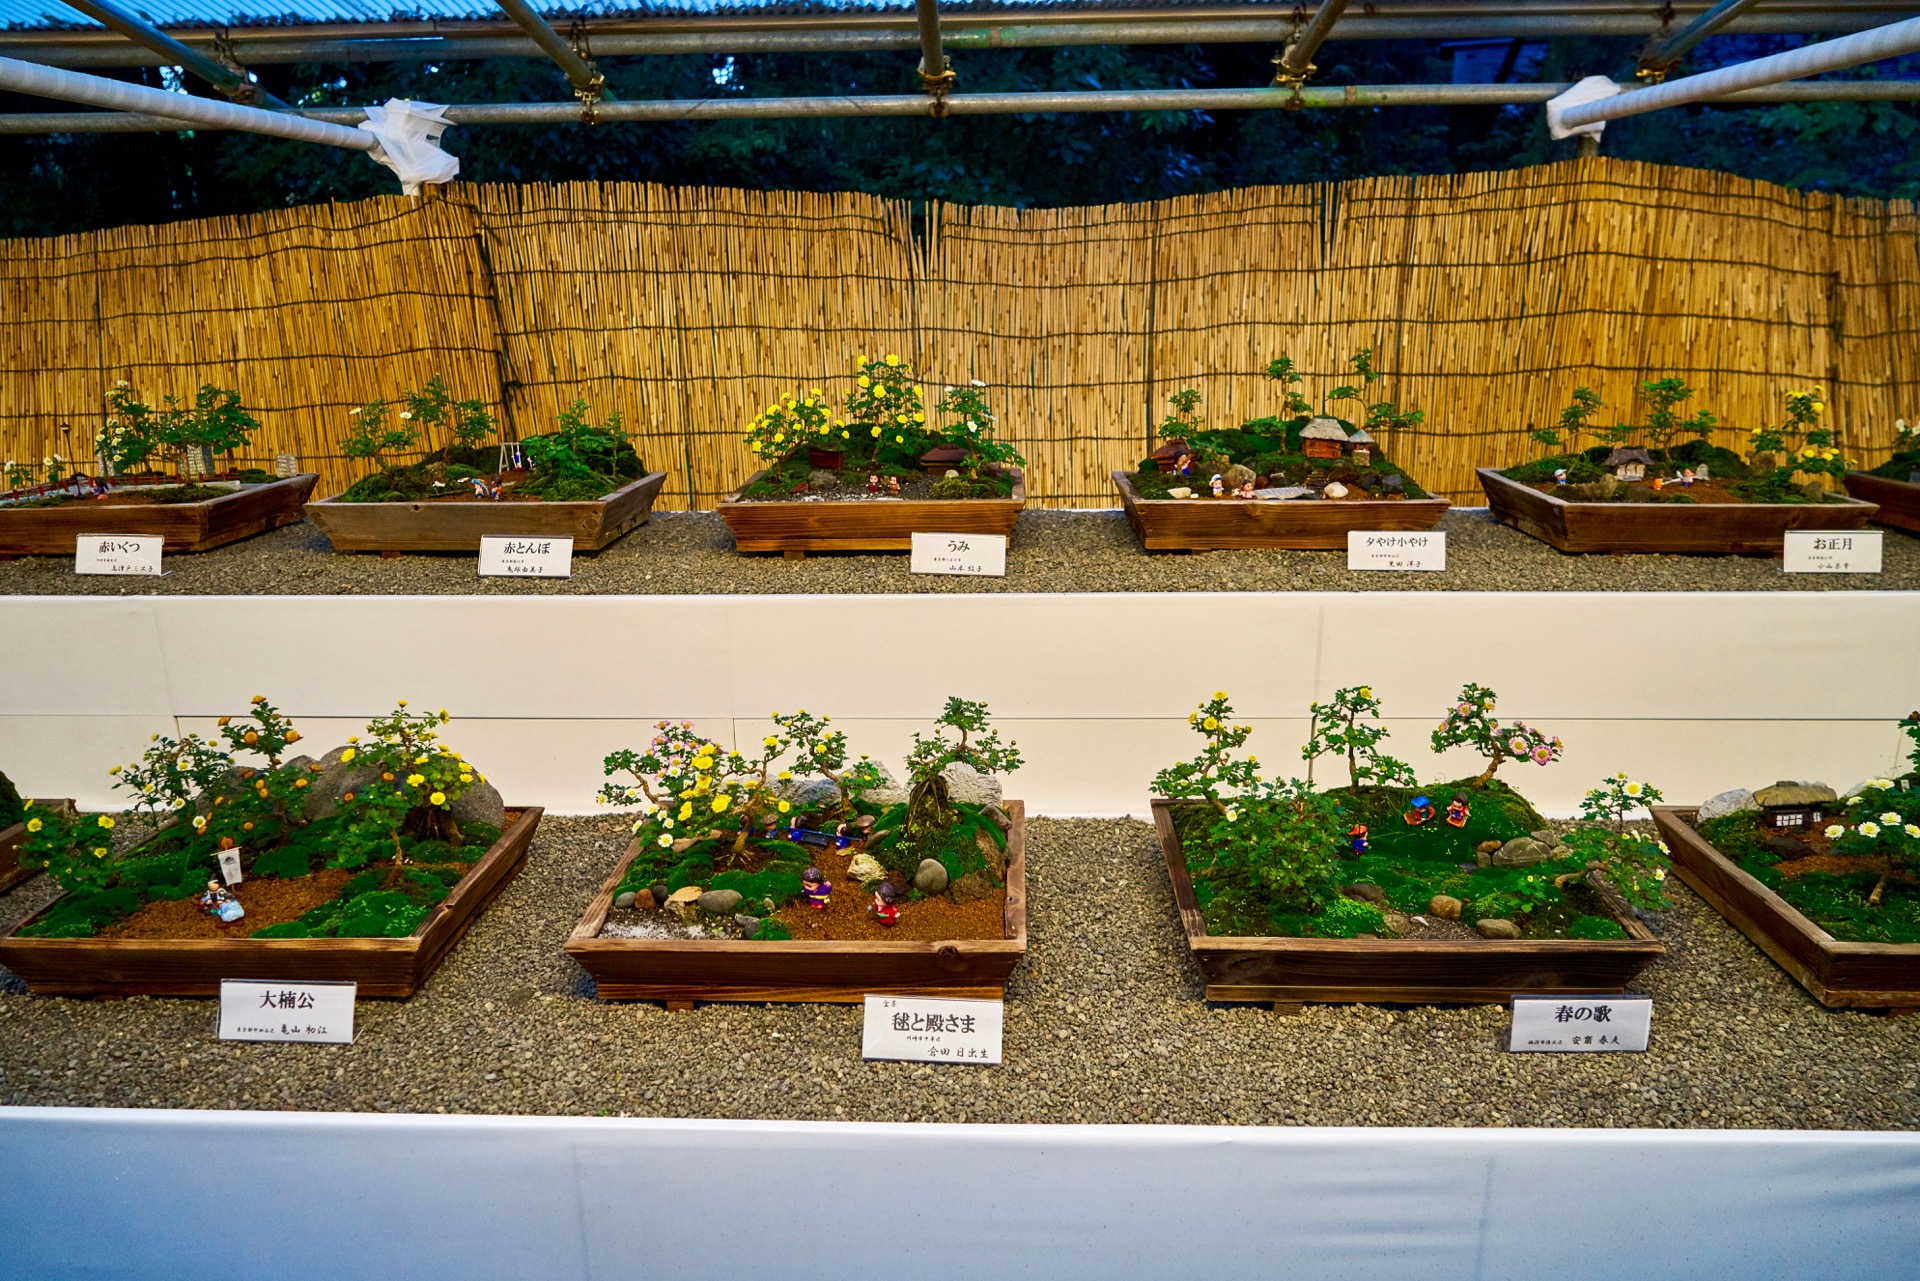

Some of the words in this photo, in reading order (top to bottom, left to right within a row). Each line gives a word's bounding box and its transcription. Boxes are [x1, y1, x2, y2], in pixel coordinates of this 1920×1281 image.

[98, 540, 141, 554] 赤いくつ
[503, 541, 552, 555] 赤とんぼ
[947, 539, 971, 553] うみ
[1366, 536, 1429, 548] 夕やけ小やけ
[1813, 537, 1853, 551] お正月
[259, 991, 316, 1010] 大楠公
[1553, 1005, 1613, 1023] 春の歌
[891, 1012, 976, 1034] 毬と殿さま
[927, 1045, 951, 1058] 倉田
[956, 1047, 989, 1059] 日出生
